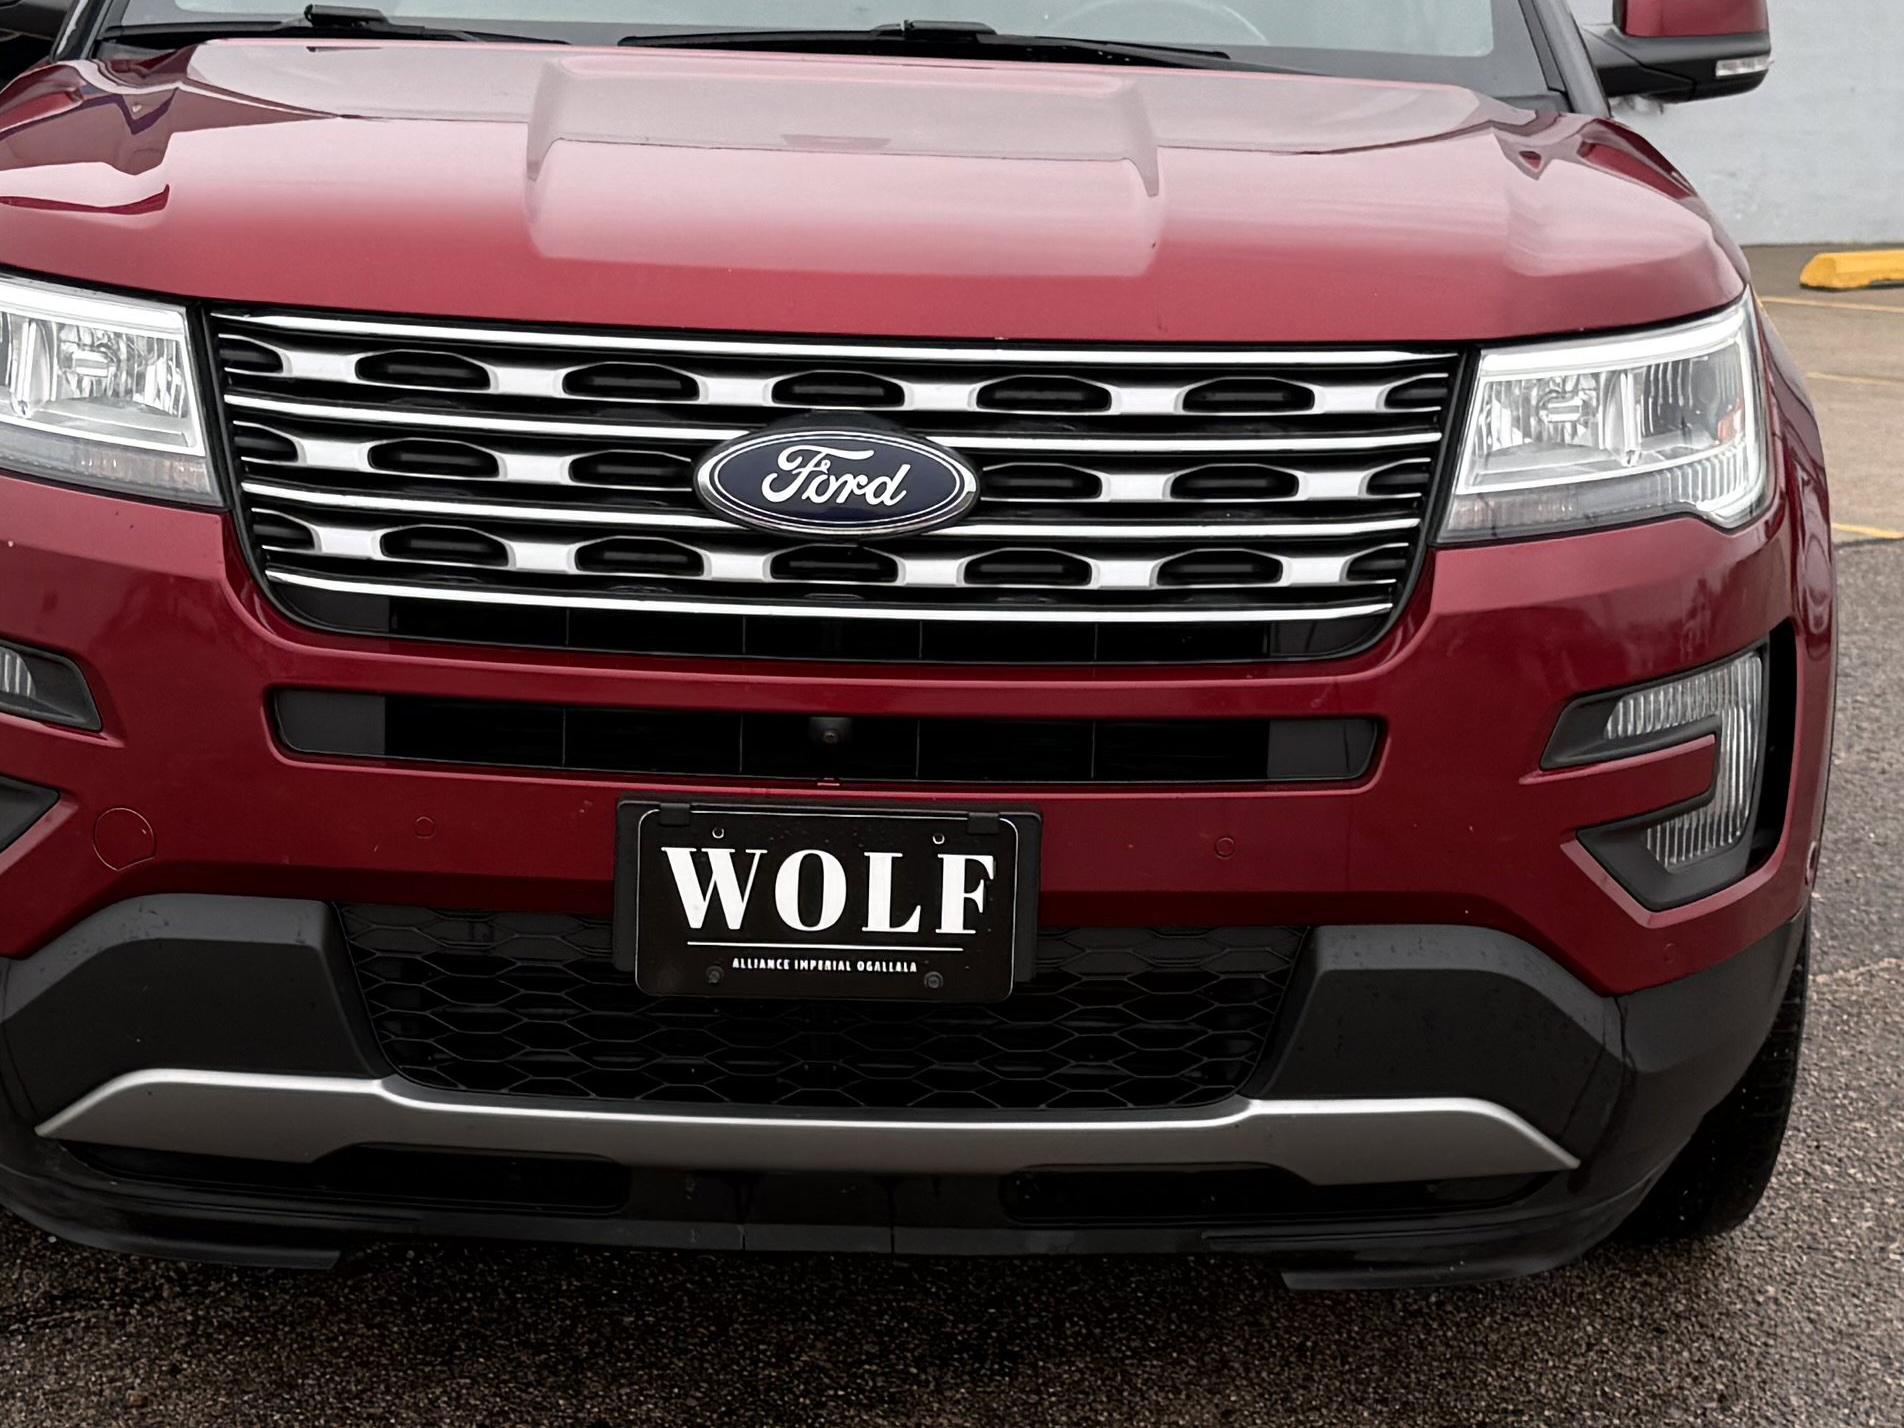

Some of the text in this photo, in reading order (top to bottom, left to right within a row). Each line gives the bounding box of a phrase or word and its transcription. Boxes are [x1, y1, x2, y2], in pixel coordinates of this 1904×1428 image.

[761, 444, 911, 506] Ford
[661, 846, 996, 934] WOLF
[732, 957, 917, 972] ALLIANCE IMPERIAL OGALLALA
